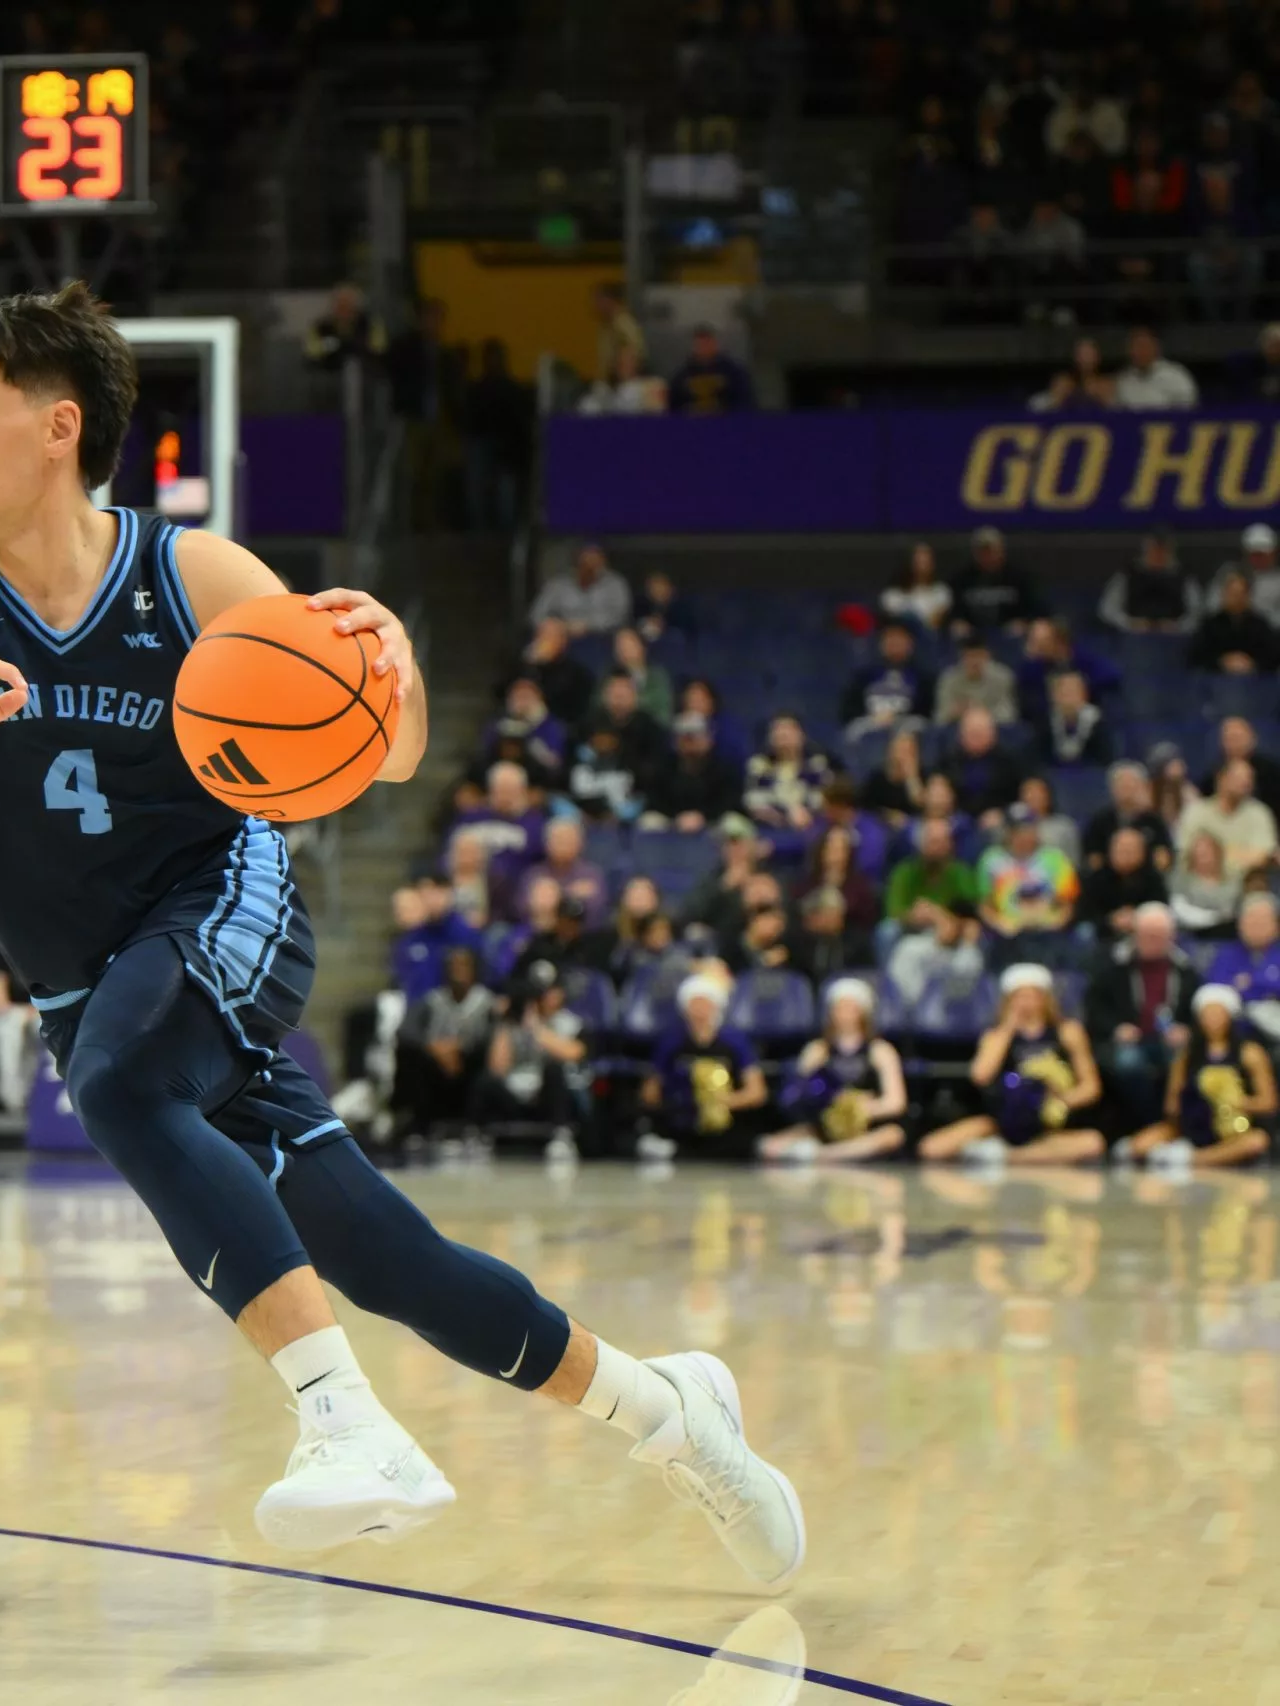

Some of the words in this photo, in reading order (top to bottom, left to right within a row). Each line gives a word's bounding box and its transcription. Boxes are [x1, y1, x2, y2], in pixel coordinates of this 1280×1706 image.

[18, 116, 123, 201] 23
[961, 423, 1113, 511] GO
[53, 684, 165, 730] DIEGO
[43, 748, 113, 835] 4
